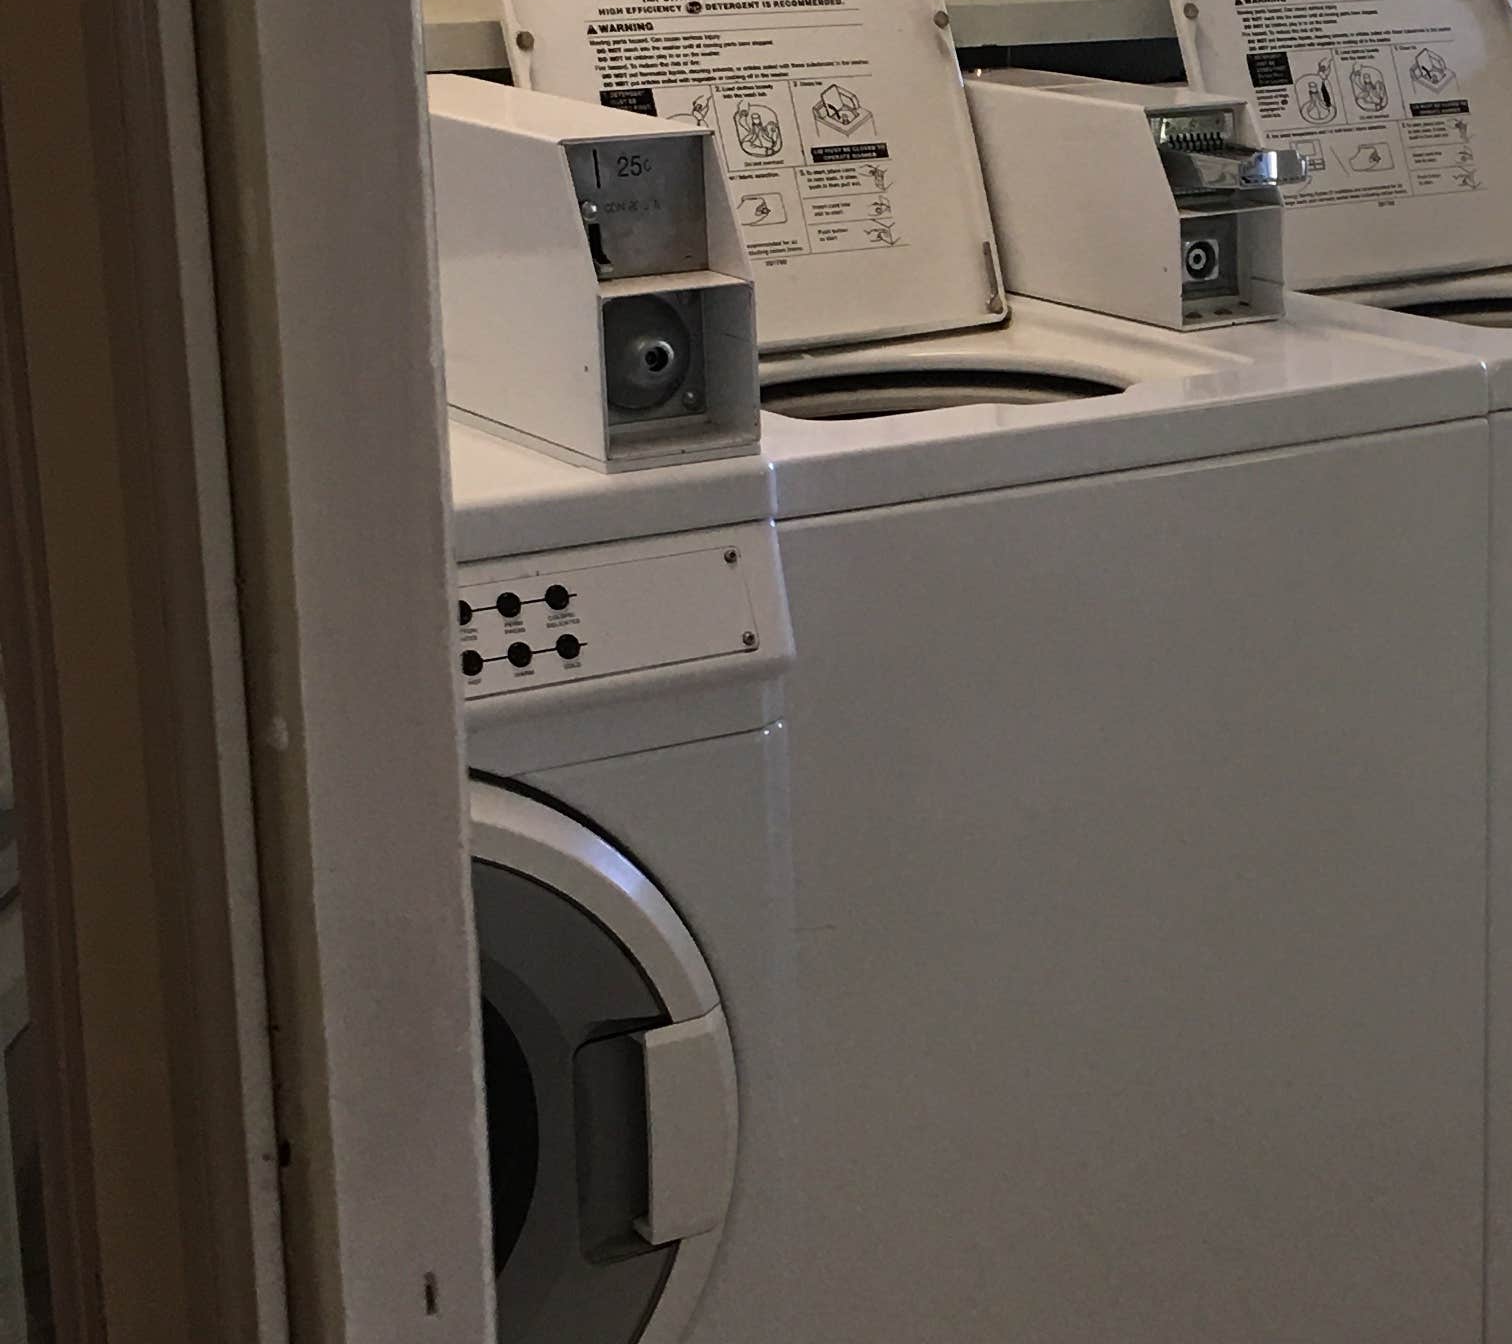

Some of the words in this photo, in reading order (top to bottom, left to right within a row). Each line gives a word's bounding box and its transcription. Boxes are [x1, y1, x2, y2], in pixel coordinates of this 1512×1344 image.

[599, 7, 624, 16] HIGH
[626, 5, 682, 14] EFFICIENCY
[705, 1, 760, 10] DETERGENT
[598, 22, 655, 33] WARNING
